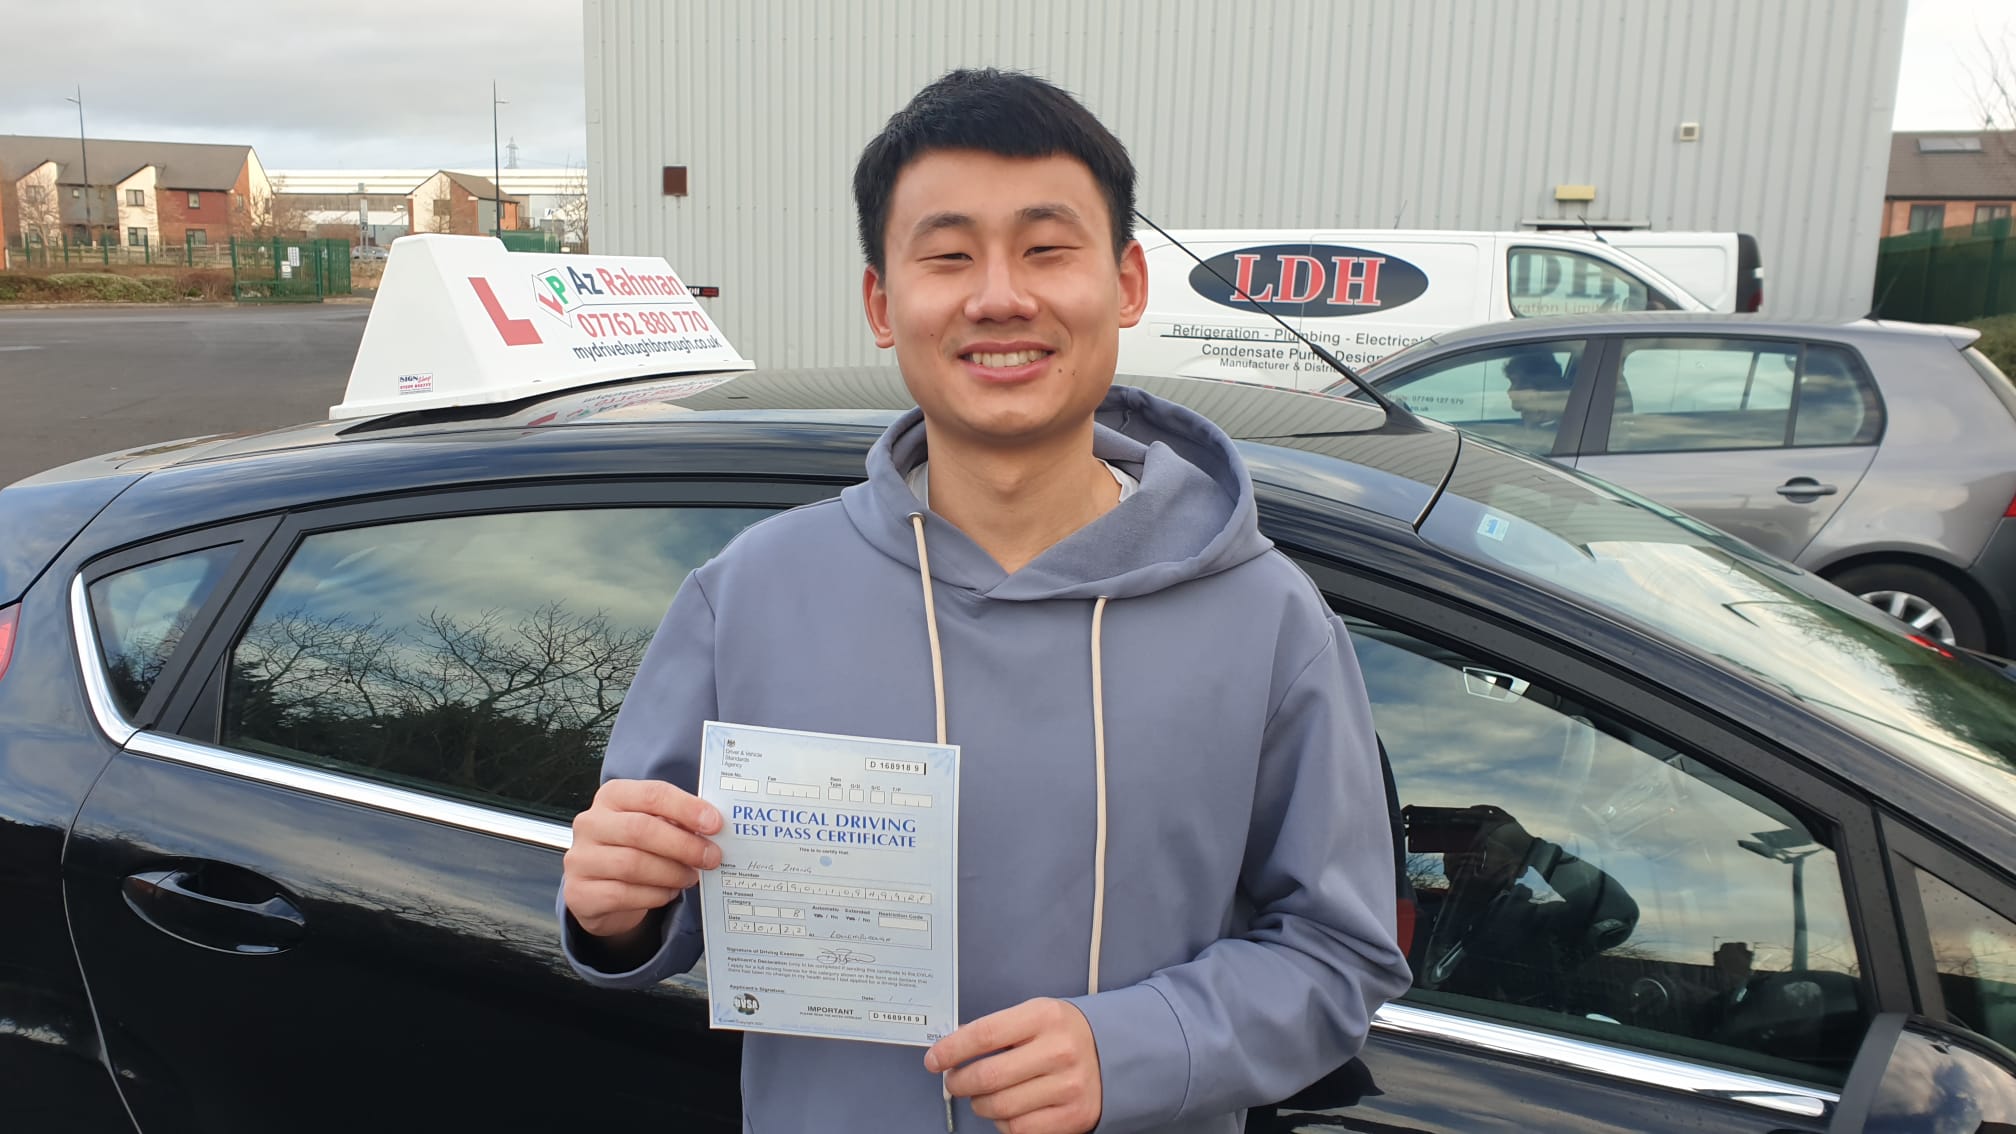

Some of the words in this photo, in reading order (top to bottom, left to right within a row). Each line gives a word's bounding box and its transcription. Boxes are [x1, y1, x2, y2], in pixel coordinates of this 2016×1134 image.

[566, 266, 604, 296] Az
[595, 267, 686, 297] Rahman
[1229, 254, 1386, 307] LDH
[467, 277, 544, 347] L
[576, 312, 645, 338] 07762
[638, 311, 677, 335] 880
[672, 310, 709, 333] 770
[1172, 324, 1260, 340] Refrigeration
[572, 334, 723, 362] mydriveloughborough.co.uk
[1201, 344, 1285, 359] Condensate
[1219, 358, 1289, 370] Manufacturer
[732, 805, 829, 826] PRACTICAL
[835, 813, 917, 833] DRIVING
[732, 823, 769, 837] TEST
[774, 826, 812, 840] PASS
[817, 829, 917, 848] CERTIFICATE
[807, 1005, 854, 1015] IMPORTANT
